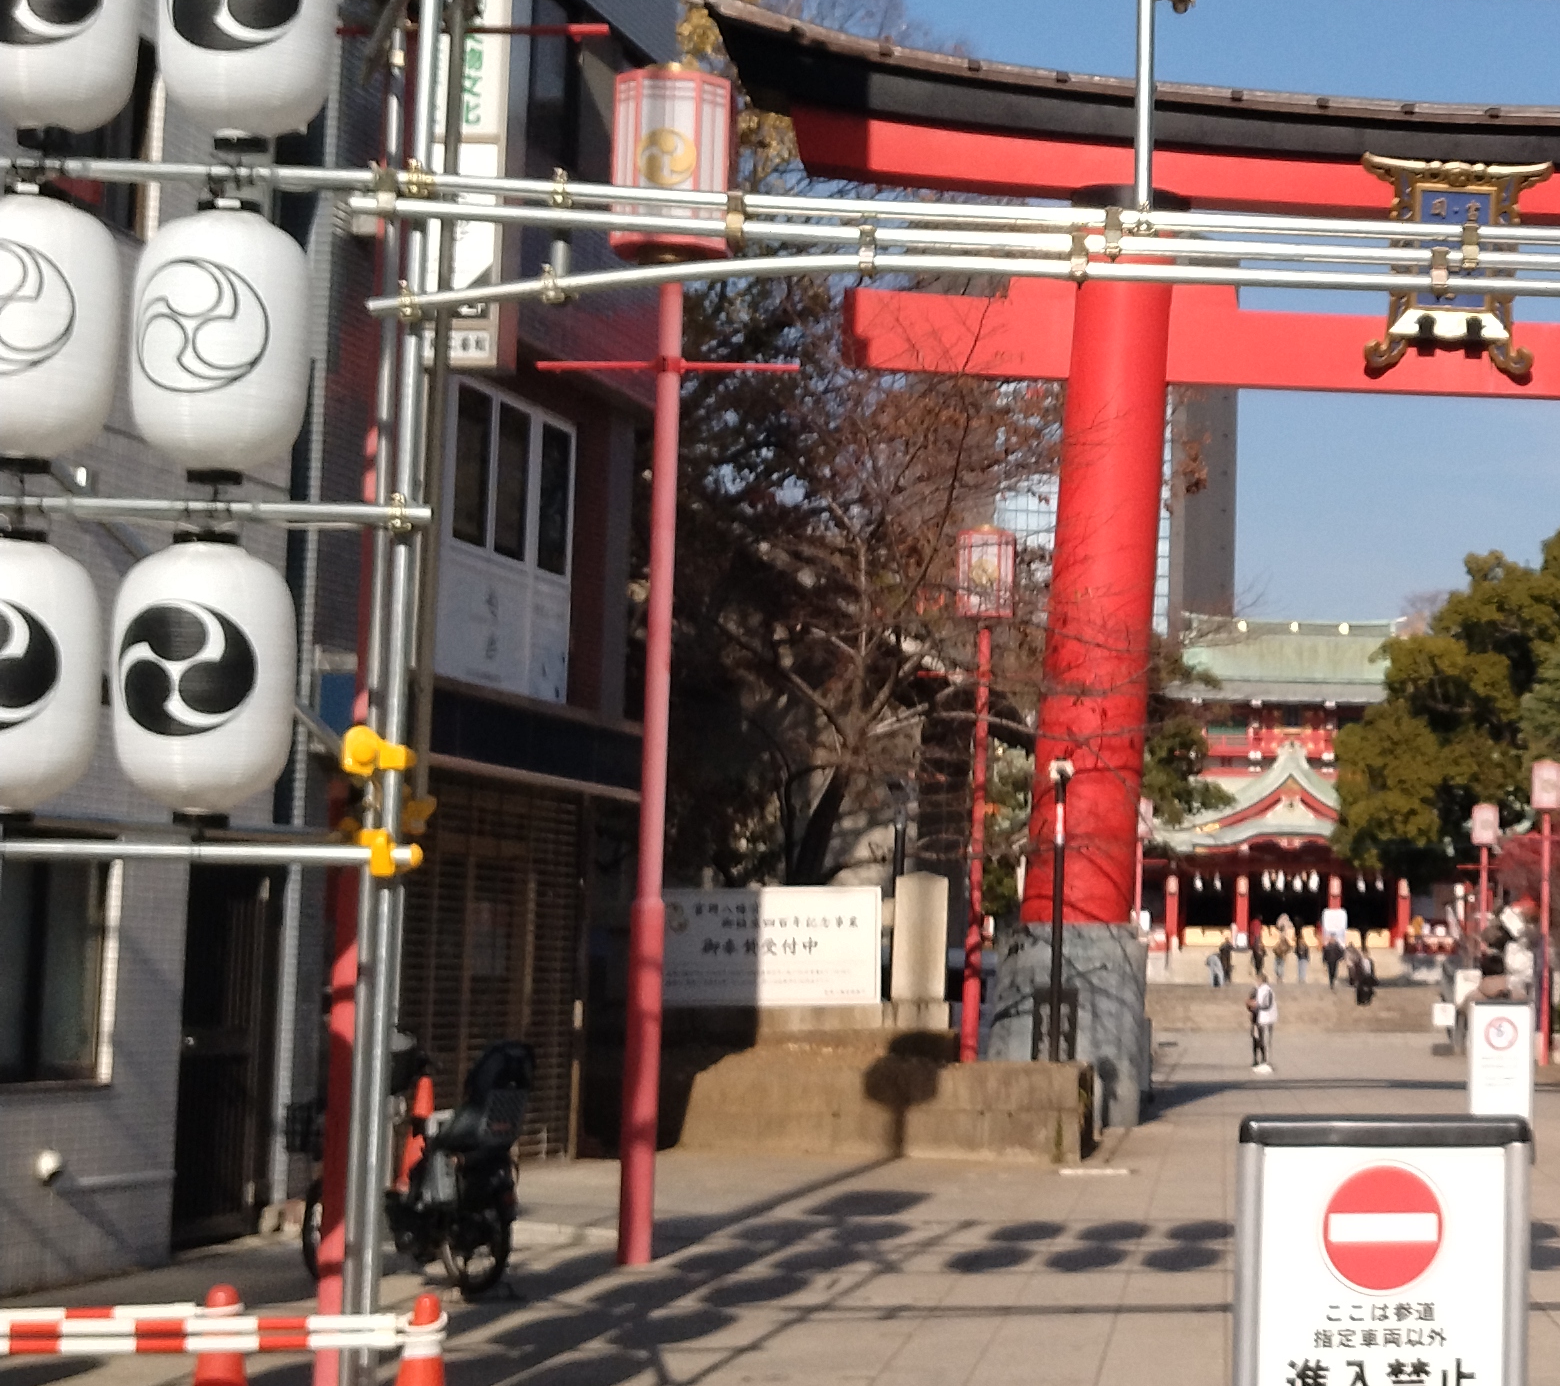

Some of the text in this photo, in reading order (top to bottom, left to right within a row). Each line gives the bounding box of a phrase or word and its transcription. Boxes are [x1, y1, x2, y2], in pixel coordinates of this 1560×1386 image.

[1326, 1302, 1435, 1322] ここは参道
[1314, 1328, 1448, 1348] 指定車両以外
